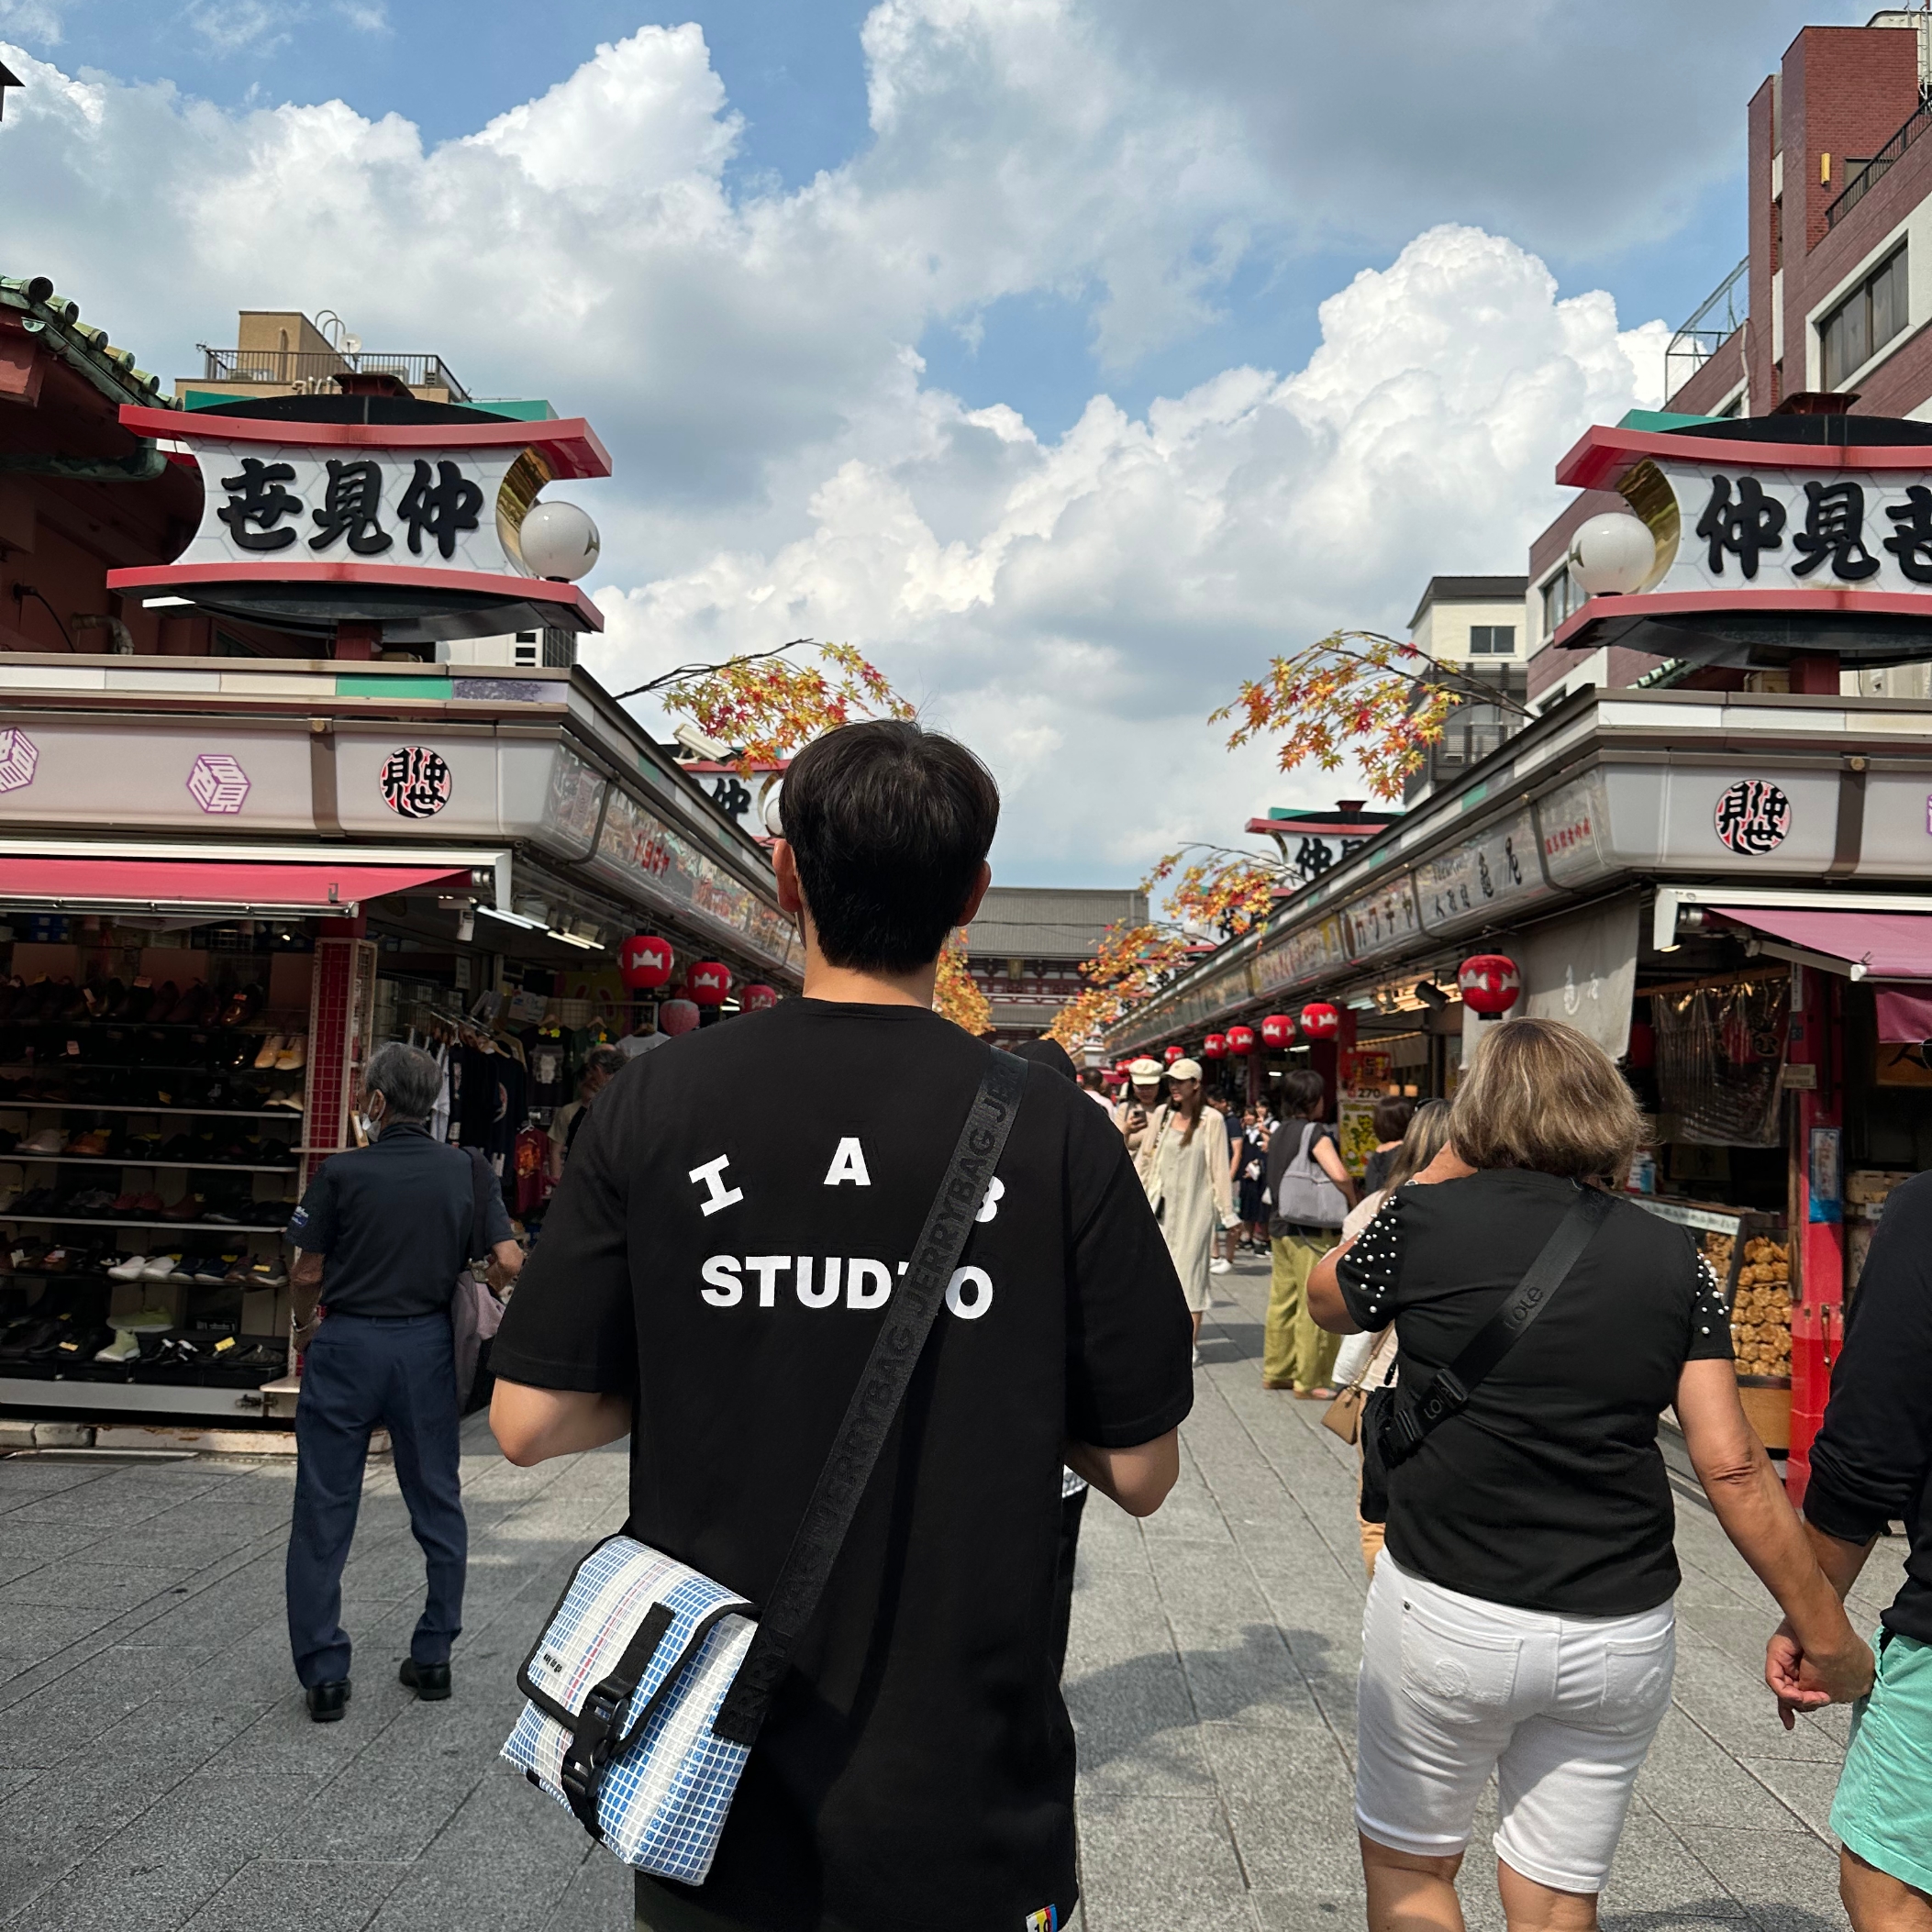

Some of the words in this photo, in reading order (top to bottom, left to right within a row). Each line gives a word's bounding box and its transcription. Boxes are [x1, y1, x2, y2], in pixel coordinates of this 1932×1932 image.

[689, 1154, 743, 1216] I
[824, 1138, 871, 1185] A
[701, 1255, 994, 1319] STUDO
